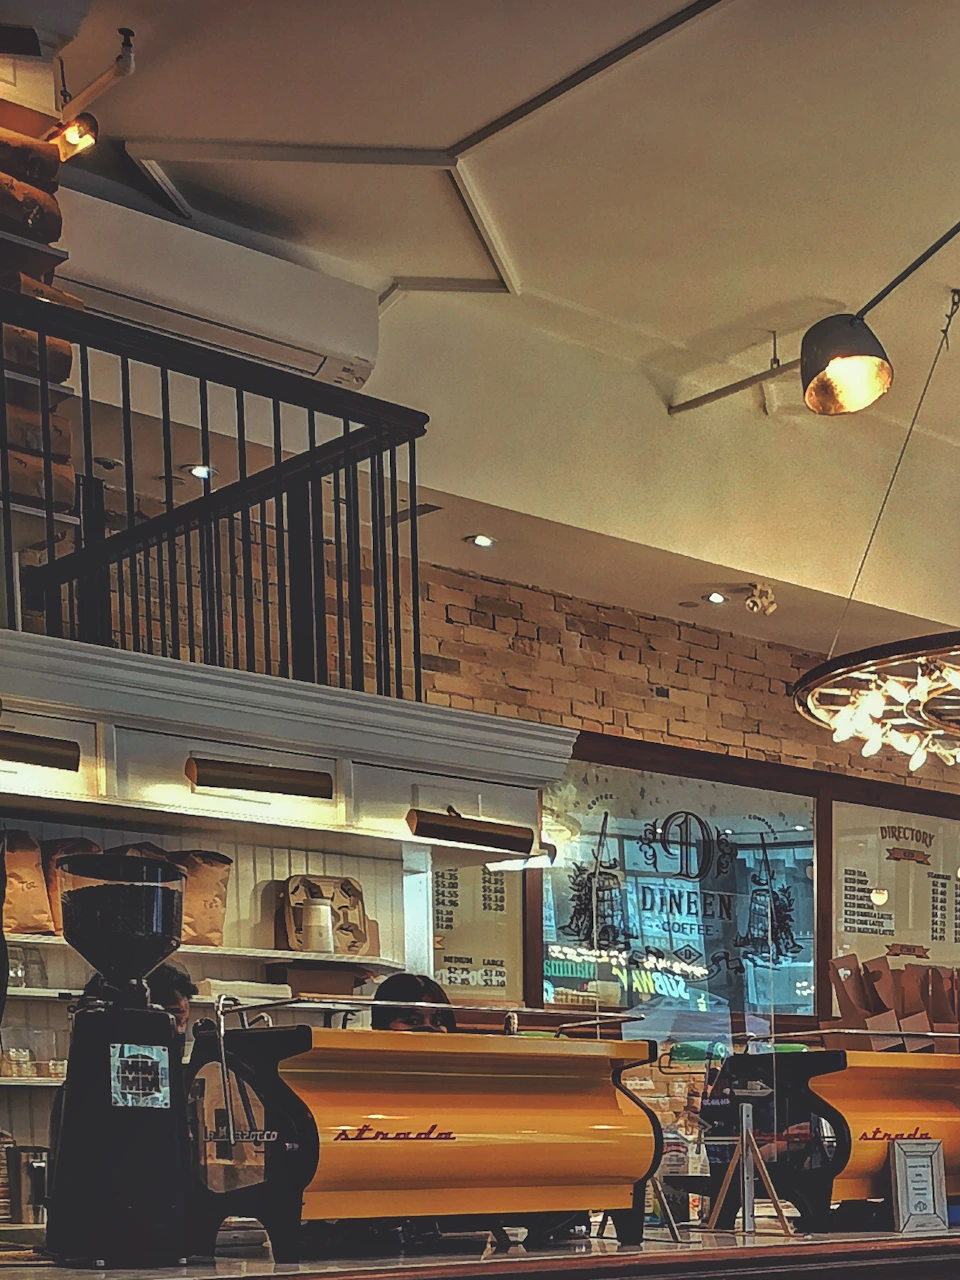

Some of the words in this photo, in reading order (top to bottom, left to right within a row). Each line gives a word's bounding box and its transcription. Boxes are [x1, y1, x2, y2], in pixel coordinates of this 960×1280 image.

[587, 793, 614, 810] COFFEE
[880, 825, 935, 848] DIRECTORY
[641, 885, 732, 921] DINEEN
[661, 921, 714, 937] COFFEE
[443, 955, 472, 964] MEDIUM
[482, 959, 505, 967] LARGE
[334, 1124, 457, 1141] strada
[859, 1127, 932, 1141] strada
